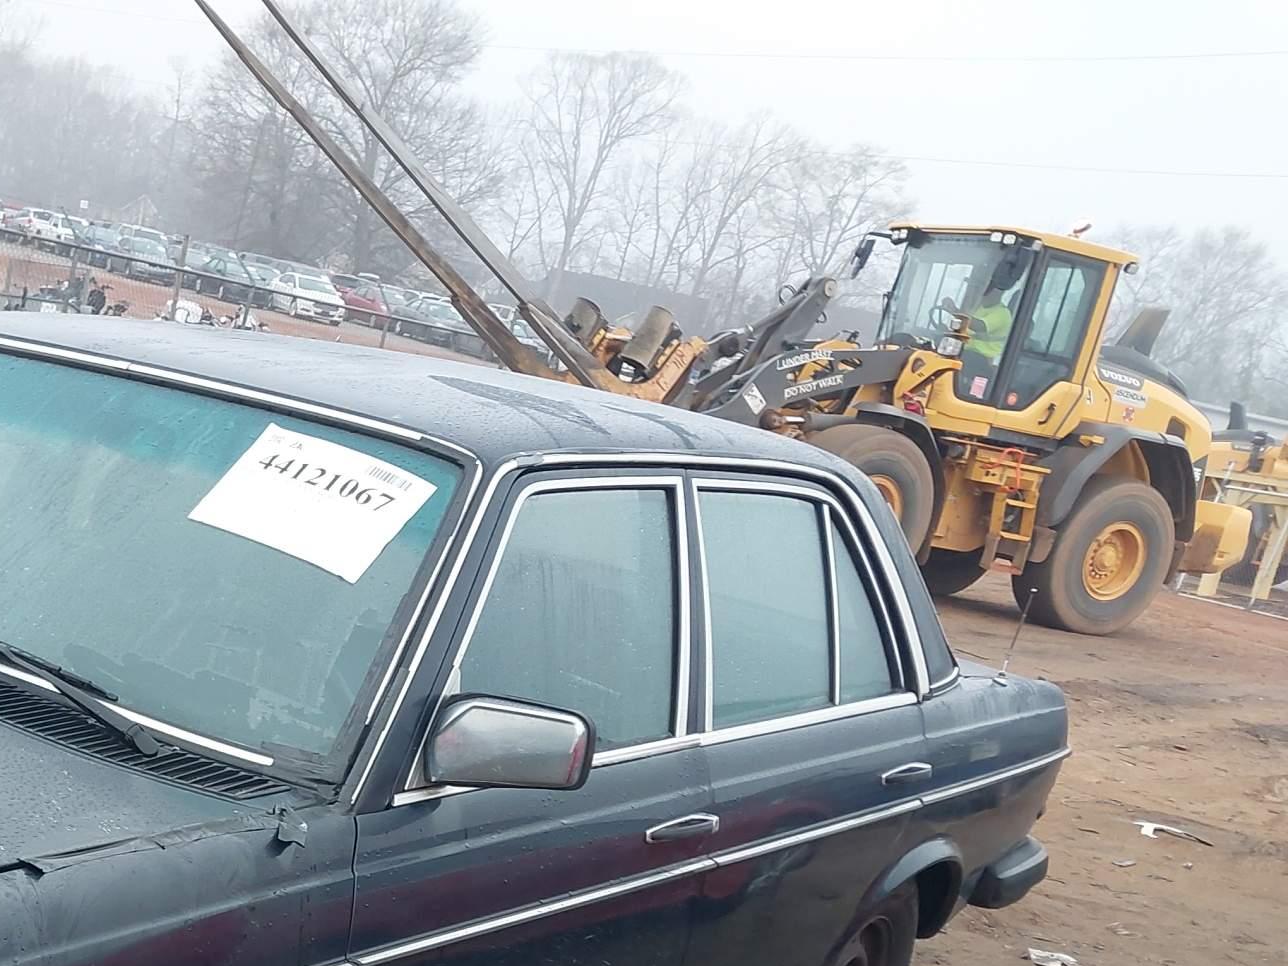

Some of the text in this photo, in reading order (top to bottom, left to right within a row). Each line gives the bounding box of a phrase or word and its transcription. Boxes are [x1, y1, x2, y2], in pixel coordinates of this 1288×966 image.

[781, 353, 810, 368] UNDER
[784, 375, 844, 400] DO NOT WALK
[1100, 368, 1141, 387] VOLVO
[258, 453, 396, 512] 44121067
